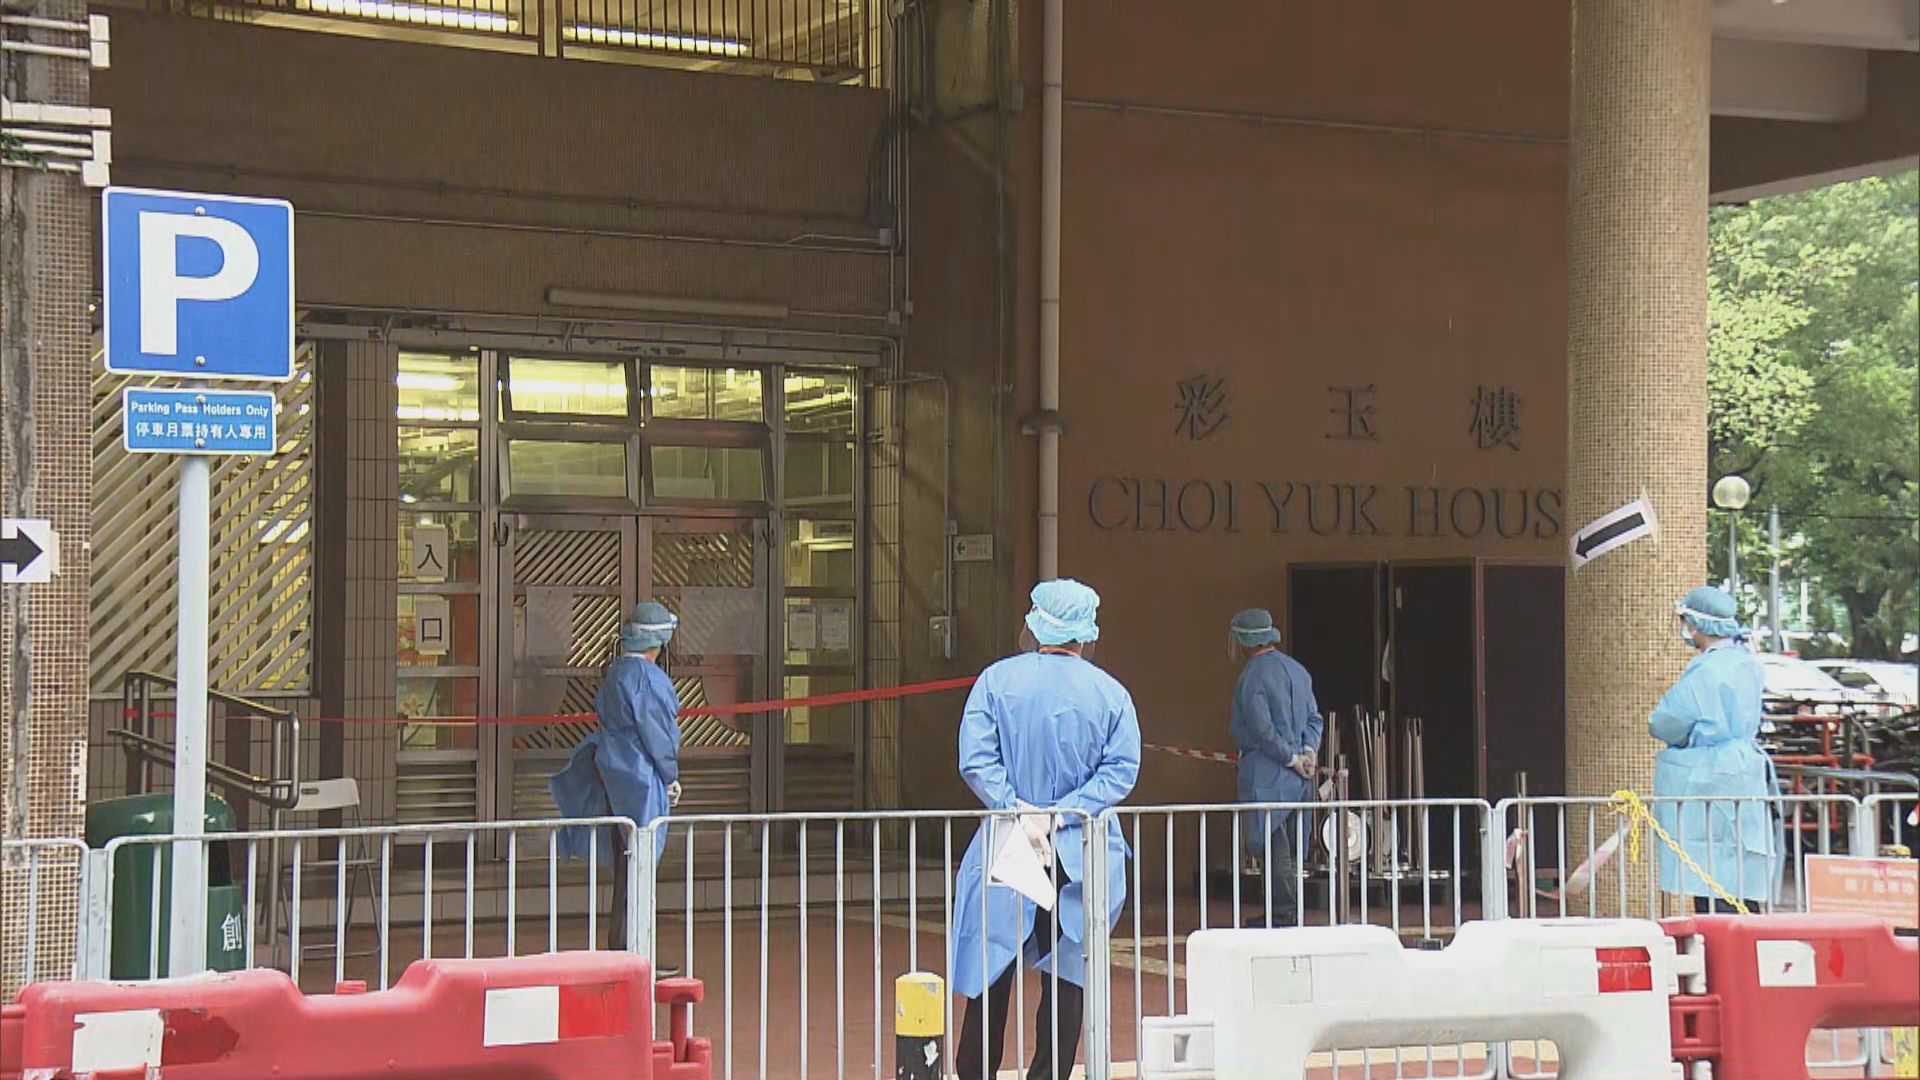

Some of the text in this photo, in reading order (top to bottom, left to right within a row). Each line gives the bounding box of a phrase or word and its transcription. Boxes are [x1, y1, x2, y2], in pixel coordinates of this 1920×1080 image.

[139, 211, 260, 355] P
[131, 402, 269, 417] Parking Pass Holders Only
[1174, 375, 1522, 451] 彩玉樓
[135, 421, 267, 440] 停車月票持有人專用
[1089, 477, 1562, 540] CHOI YUK HOUS
[417, 544, 443, 570] 入
[421, 618, 442, 642] 口
